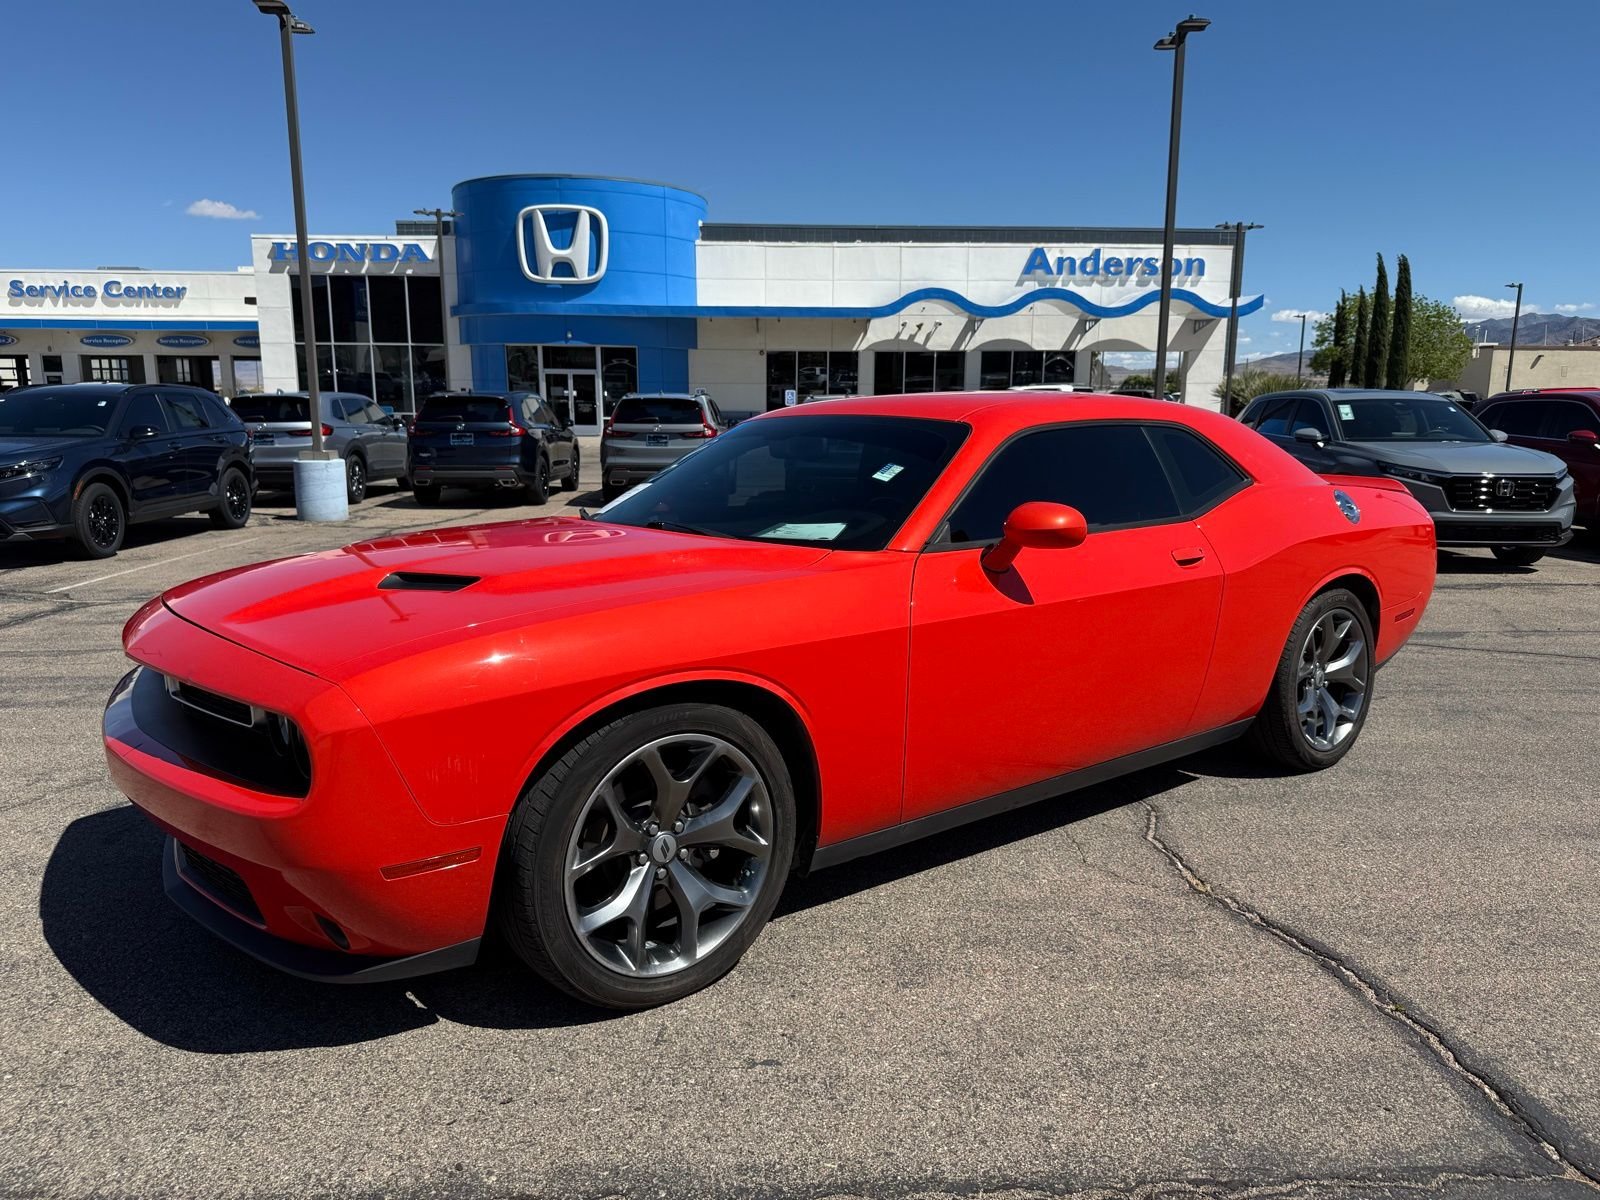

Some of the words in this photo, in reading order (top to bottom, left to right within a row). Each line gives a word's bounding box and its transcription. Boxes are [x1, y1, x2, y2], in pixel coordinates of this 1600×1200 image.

[271, 241, 435, 263] HONDA
[1022, 246, 1206, 277] Anderson
[9, 279, 97, 299] Service
[103, 280, 188, 300] Center
